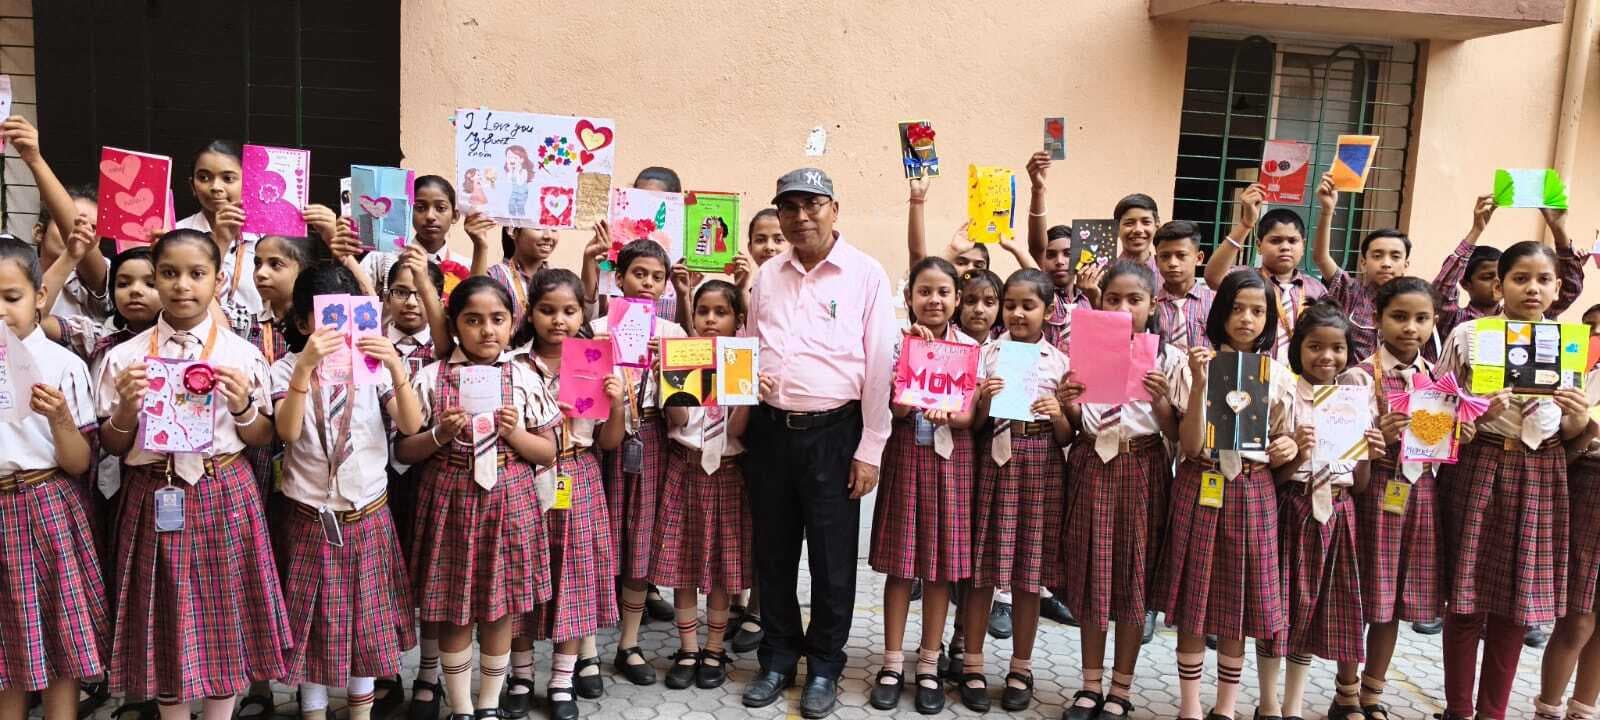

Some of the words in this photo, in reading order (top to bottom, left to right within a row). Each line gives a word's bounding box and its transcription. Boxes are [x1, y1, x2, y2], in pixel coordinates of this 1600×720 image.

[464, 112, 474, 130] I
[483, 112, 510, 131] Love
[510, 123, 534, 137] you
[465, 131, 480, 152] My
[905, 367, 967, 396] MOM
